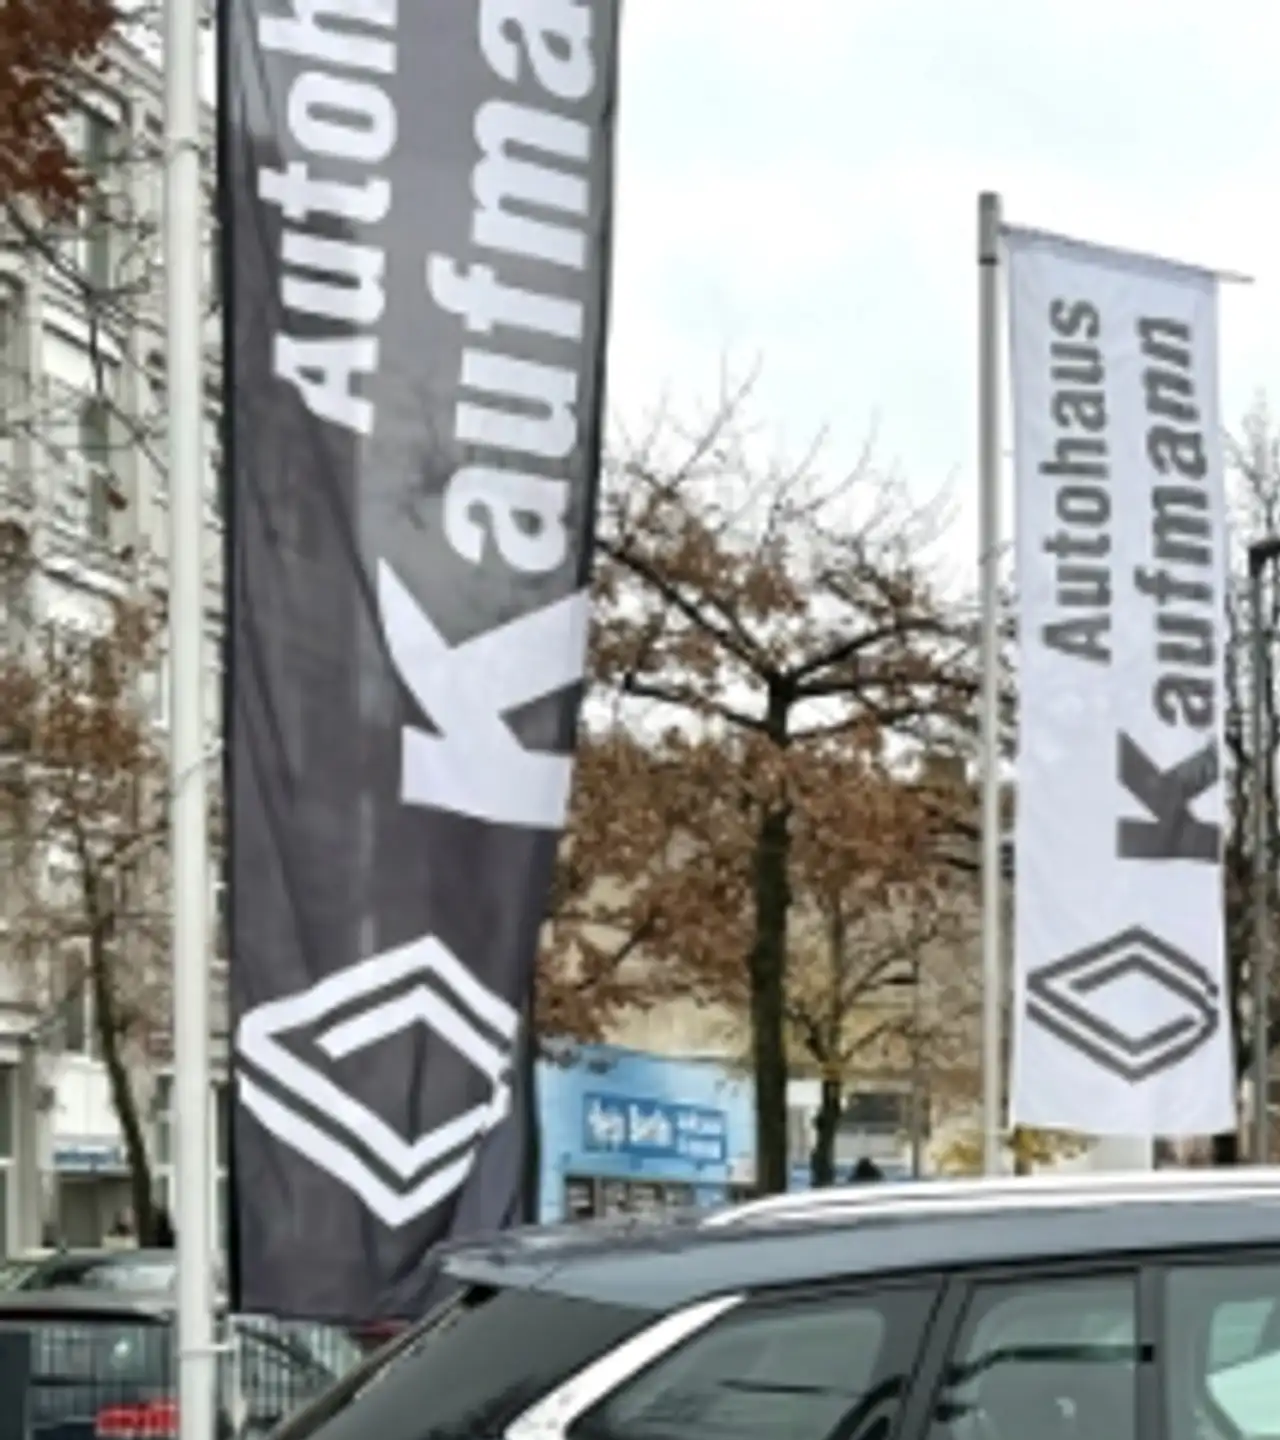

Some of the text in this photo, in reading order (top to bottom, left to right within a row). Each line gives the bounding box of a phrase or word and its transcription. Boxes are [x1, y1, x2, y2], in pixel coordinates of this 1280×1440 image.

[257, 0, 399, 435] Autoh
[376, 0, 597, 829] Kaufma
[1038, 297, 1113, 666] Autohaus
[1116, 314, 1222, 865] Kaufmann
